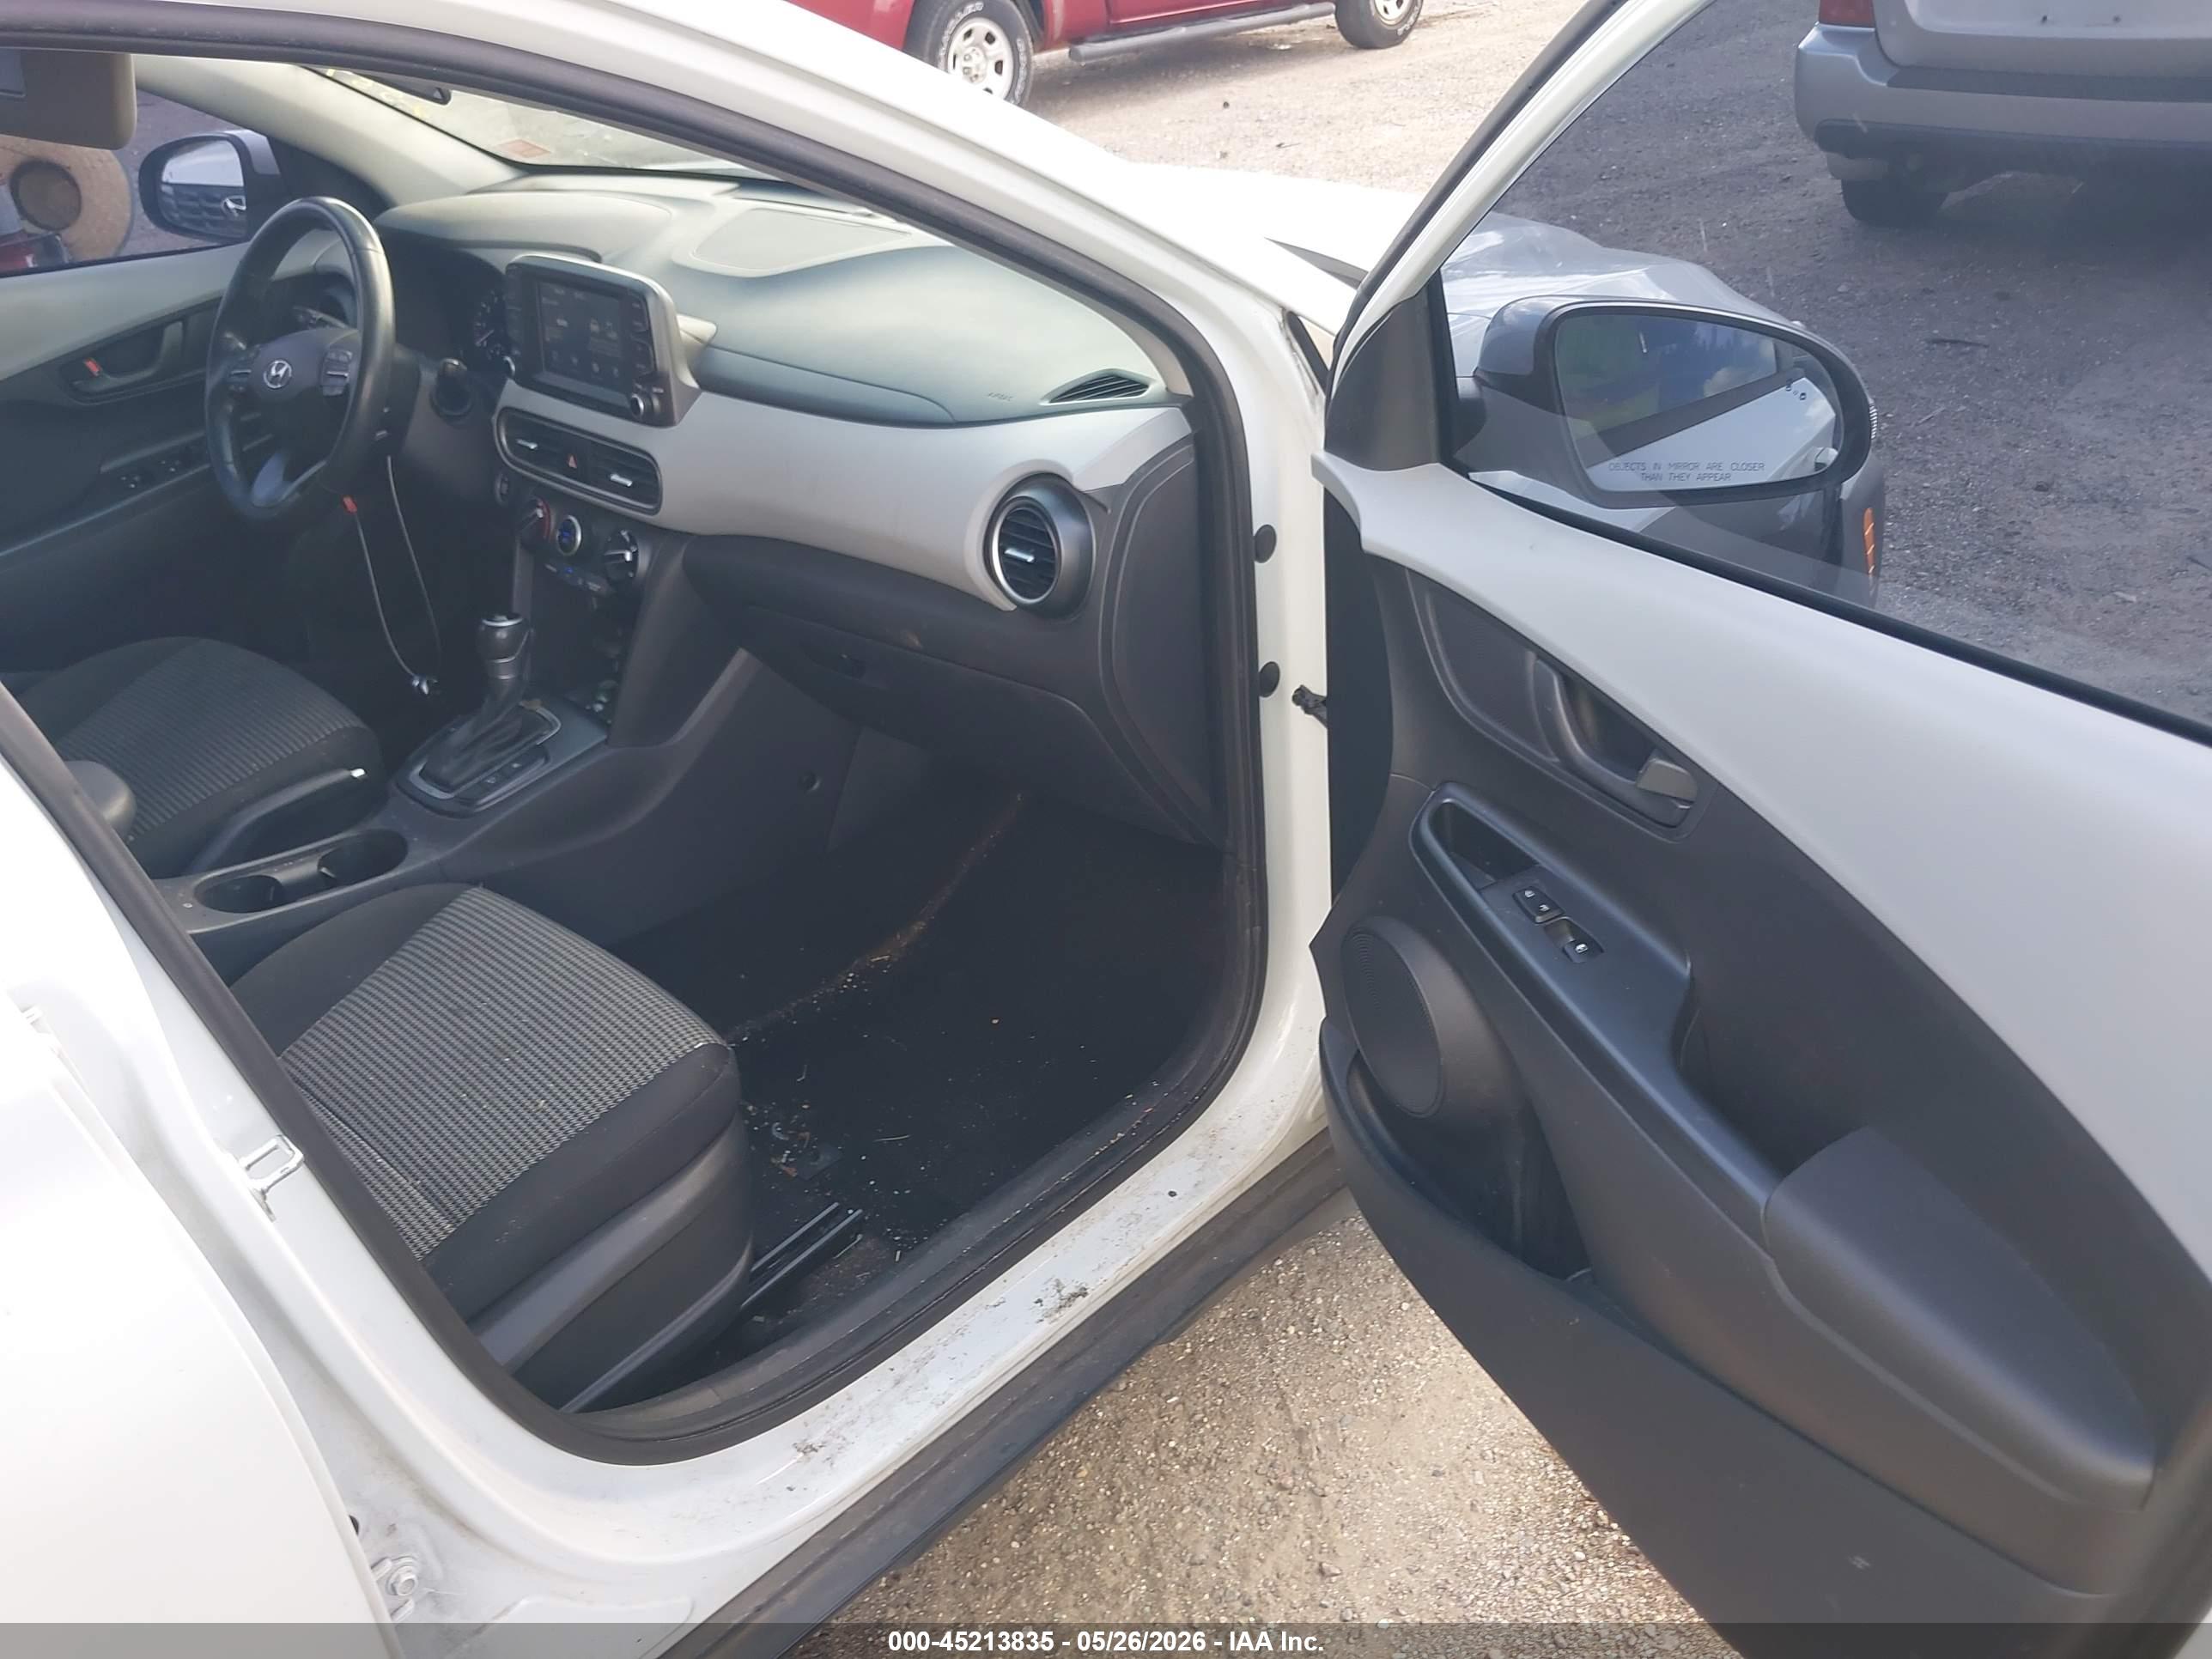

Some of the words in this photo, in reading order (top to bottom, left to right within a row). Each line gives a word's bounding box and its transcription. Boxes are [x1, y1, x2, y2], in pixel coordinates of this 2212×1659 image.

[1607, 461, 1646, 471] OBJECTS
[1652, 462, 1662, 471] IN
[1668, 461, 1700, 471] MIRROR
[1705, 462, 1723, 471] ARE
[1730, 461, 1765, 471] CLOSER
[1641, 472, 1663, 481] THAN
[1668, 472, 1691, 481] THEY
[1696, 472, 1732, 481] APPEAR
